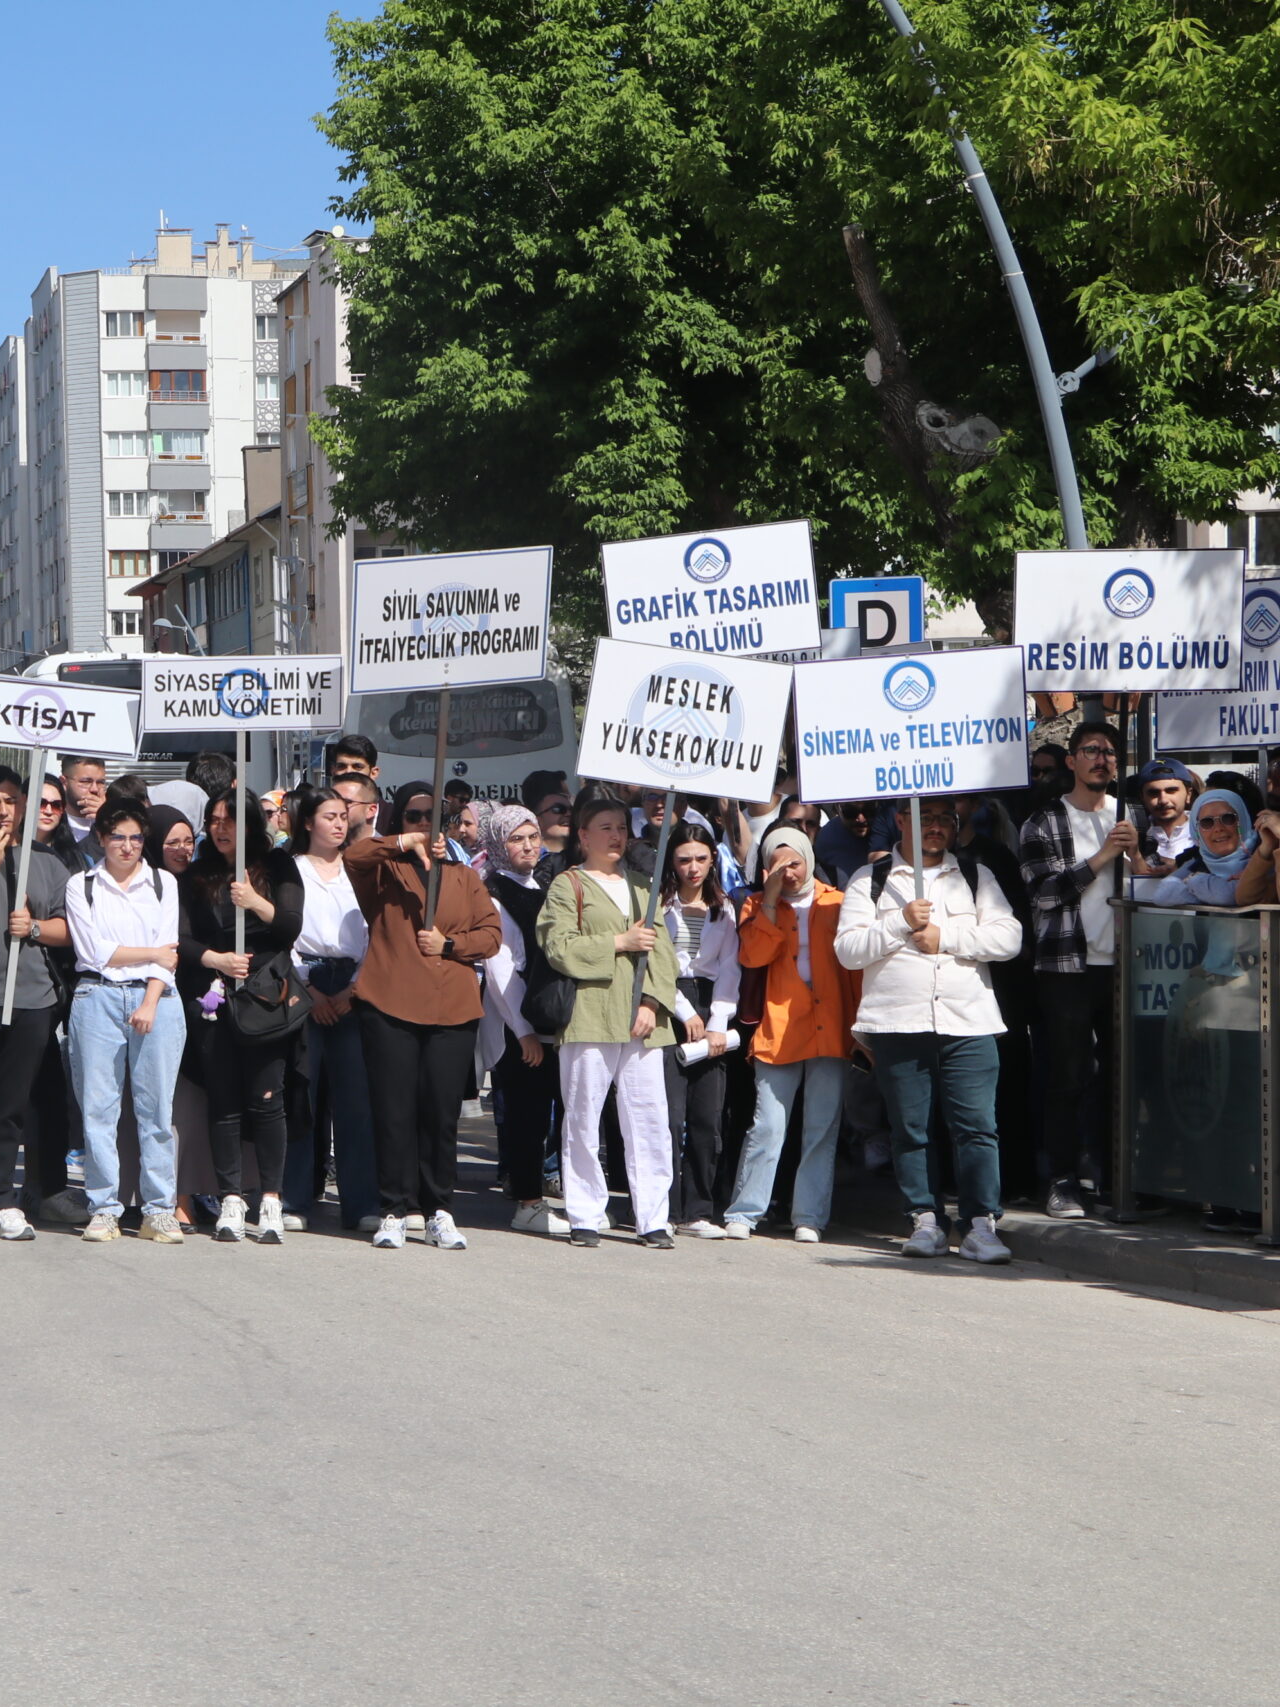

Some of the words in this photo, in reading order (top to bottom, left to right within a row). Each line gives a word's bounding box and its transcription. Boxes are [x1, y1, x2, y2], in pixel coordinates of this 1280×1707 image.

[382, 588, 421, 622] SİVİL
[426, 587, 499, 619] SAVUNMA
[504, 592, 520, 612] ve
[616, 587, 698, 625] GRAFİK
[704, 578, 810, 614] TASARIMI
[670, 618, 763, 653] BÖLÜMÜ
[858, 599, 897, 648] D
[359, 626, 456, 665] İTFAİYECİLİK
[460, 625, 540, 658] PROGRAMI
[1028, 636, 1108, 671] RESİM
[1119, 634, 1230, 670] BÖLÜMÜ
[154, 669, 236, 692] SİYASET
[242, 667, 300, 691] BİLİMİ
[307, 671, 332, 690] VE
[646, 674, 735, 714] MESLEK
[164, 699, 221, 717] KAMU
[228, 692, 322, 718] YÖNETİMİ
[415, 697, 456, 713] Tarh
[601, 718, 763, 773] YÜKSEKOKULU
[803, 726, 875, 757] SİNEMA
[881, 733, 900, 751] ve
[906, 714, 1022, 751] TELEVİZYON
[875, 757, 954, 792] BÖLÜMÜ
